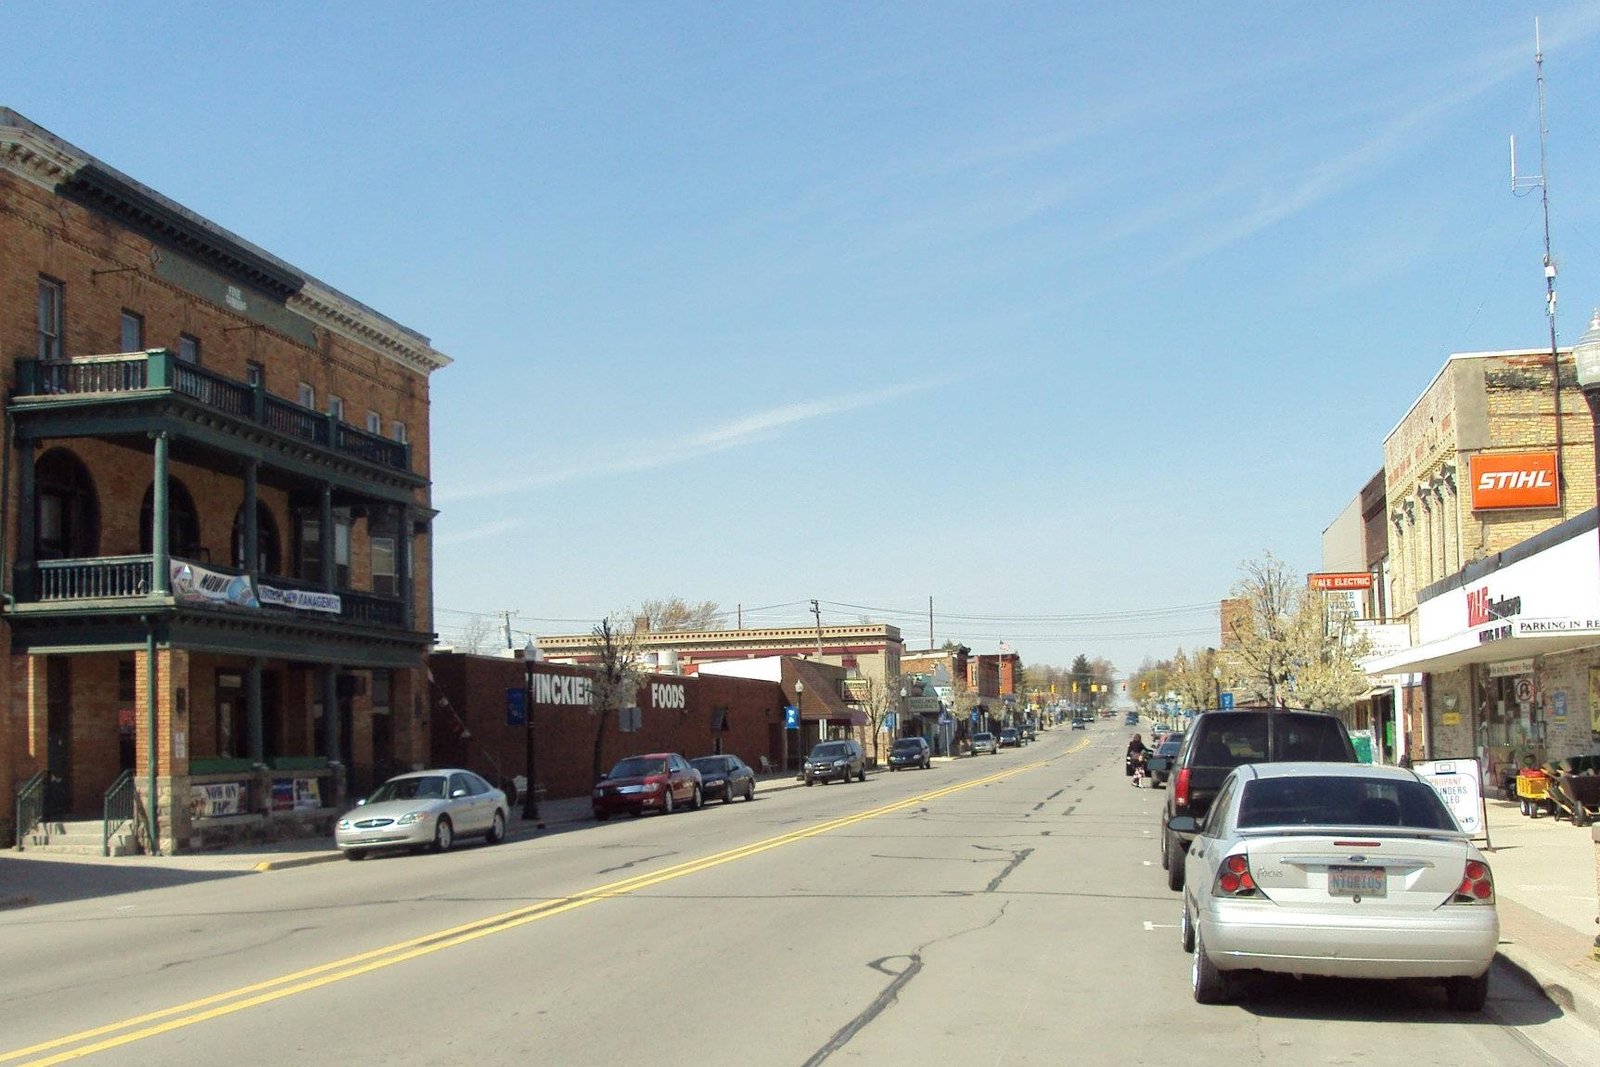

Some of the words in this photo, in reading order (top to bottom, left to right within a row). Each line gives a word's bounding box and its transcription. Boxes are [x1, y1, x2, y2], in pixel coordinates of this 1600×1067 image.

[1478, 470, 1552, 490] STIHL
[1334, 577, 1370, 586] ELECTRIC
[1520, 621, 1566, 631] PARKING
[1569, 620, 1581, 629] IN
[651, 683, 685, 709] FOODS
